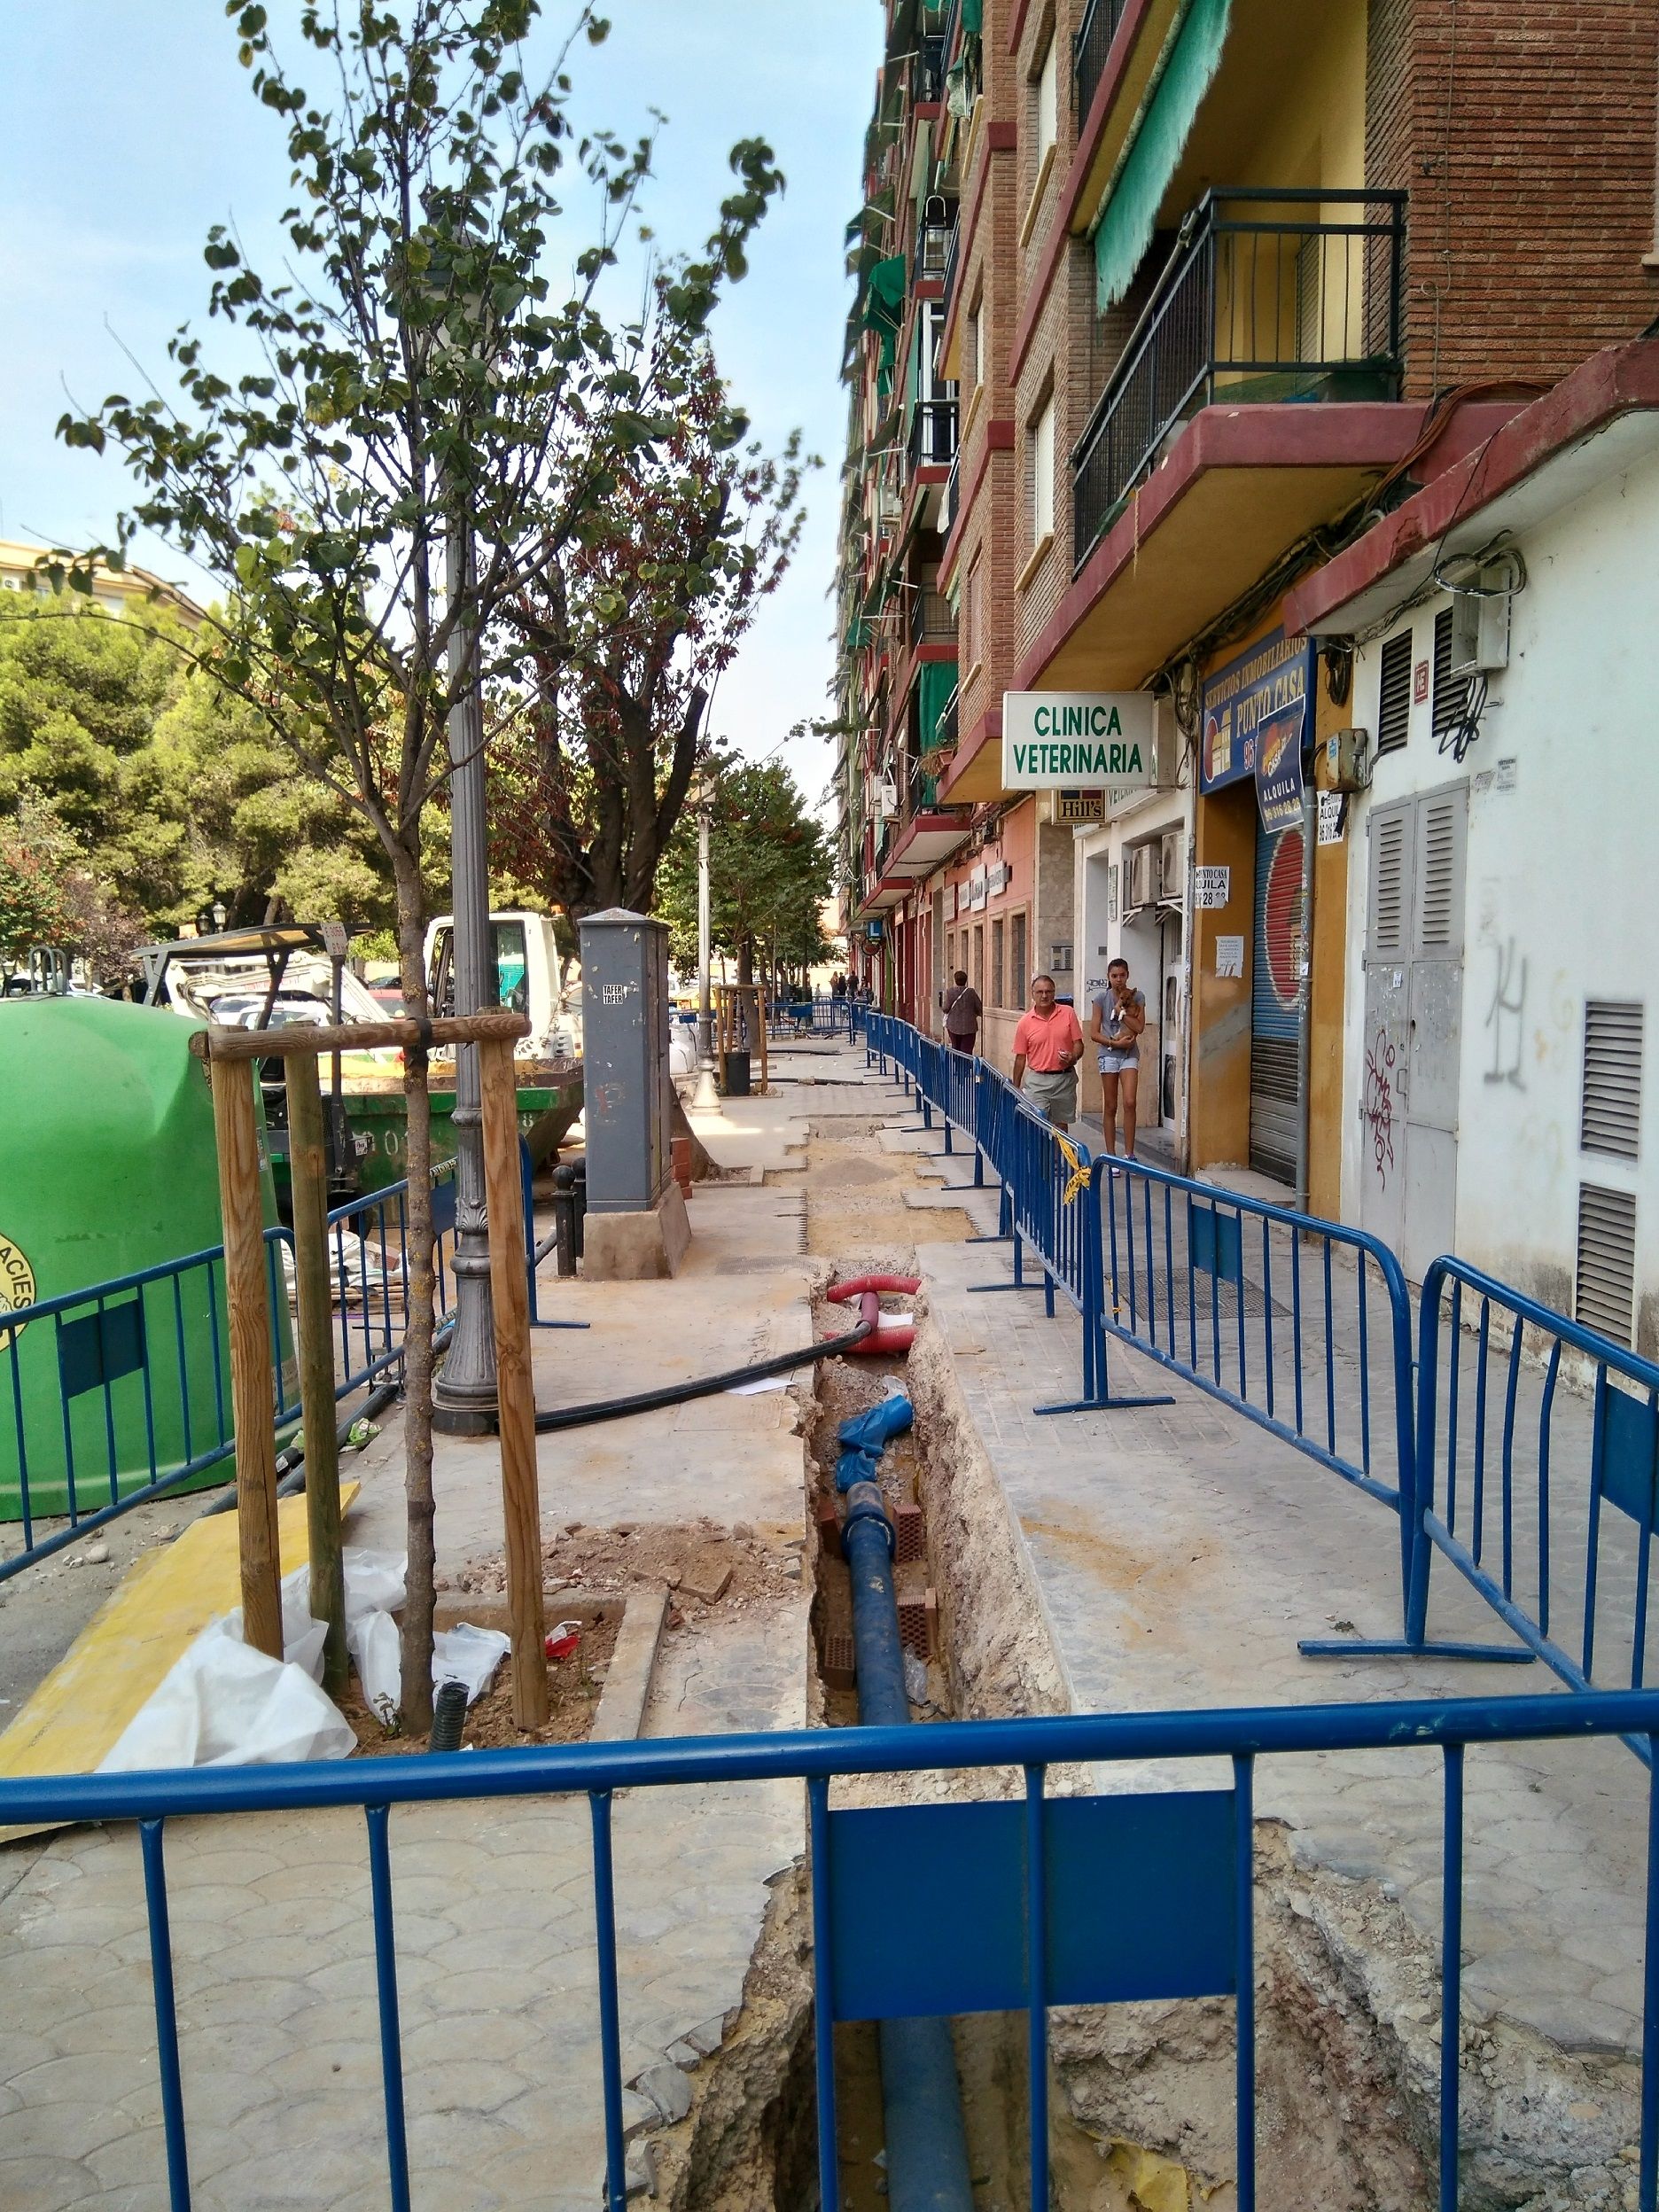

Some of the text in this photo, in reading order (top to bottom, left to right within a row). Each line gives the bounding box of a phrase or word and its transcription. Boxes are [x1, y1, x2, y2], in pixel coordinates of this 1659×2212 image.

[1205, 637, 1307, 711] SERVICIOS INMOBILIARIOS
[1236, 666, 1304, 738] PUNTO CASA
[1034, 706, 1122, 736] CLINICA
[1013, 744, 1142, 774] VETERINARIA
[1264, 776, 1296, 802] ALQUILA
[1062, 800, 1102, 817] Hill's
[1214, 869, 1227, 878] CASA
[1203, 892, 1212, 905] 28
[604, 985, 622, 994] TAFER
[604, 994, 622, 1004] TAFER
